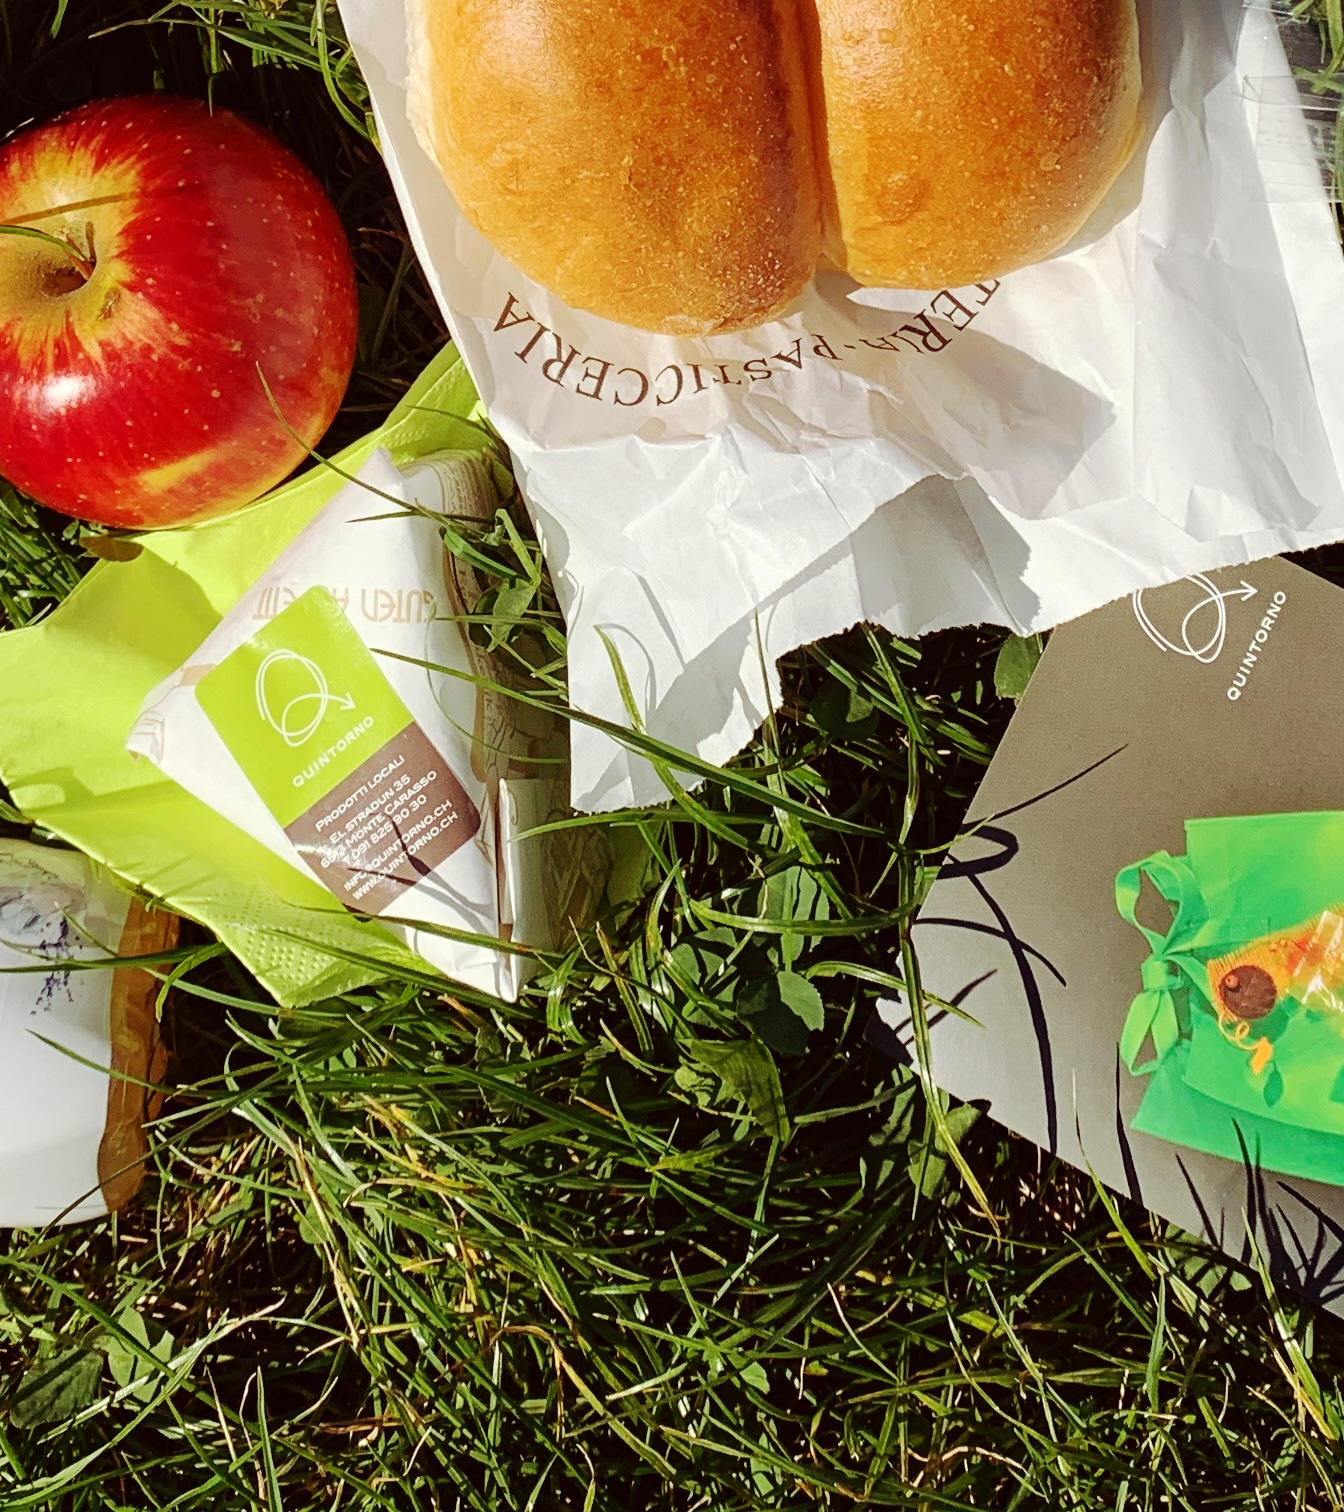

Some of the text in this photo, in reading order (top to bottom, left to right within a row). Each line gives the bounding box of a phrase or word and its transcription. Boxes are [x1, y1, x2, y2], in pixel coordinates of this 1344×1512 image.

[361, 587, 437, 624] GUTEN
[1227, 591, 1286, 700] QUINTORNO
[292, 715, 375, 788] QUINTORNO
[315, 755, 405, 832] PRODOTTI LOCALI
[330, 774, 411, 844] EL STRADUN 35
[346, 812, 386, 849] MONTE
[384, 770, 437, 815] CARASSO
[351, 839, 371, 862] 091
[370, 823, 394, 845] 825
[392, 808, 409, 826] 90
[411, 794, 427, 813] 30
[352, 810, 459, 900] WWW.QUINTORNO.CH
